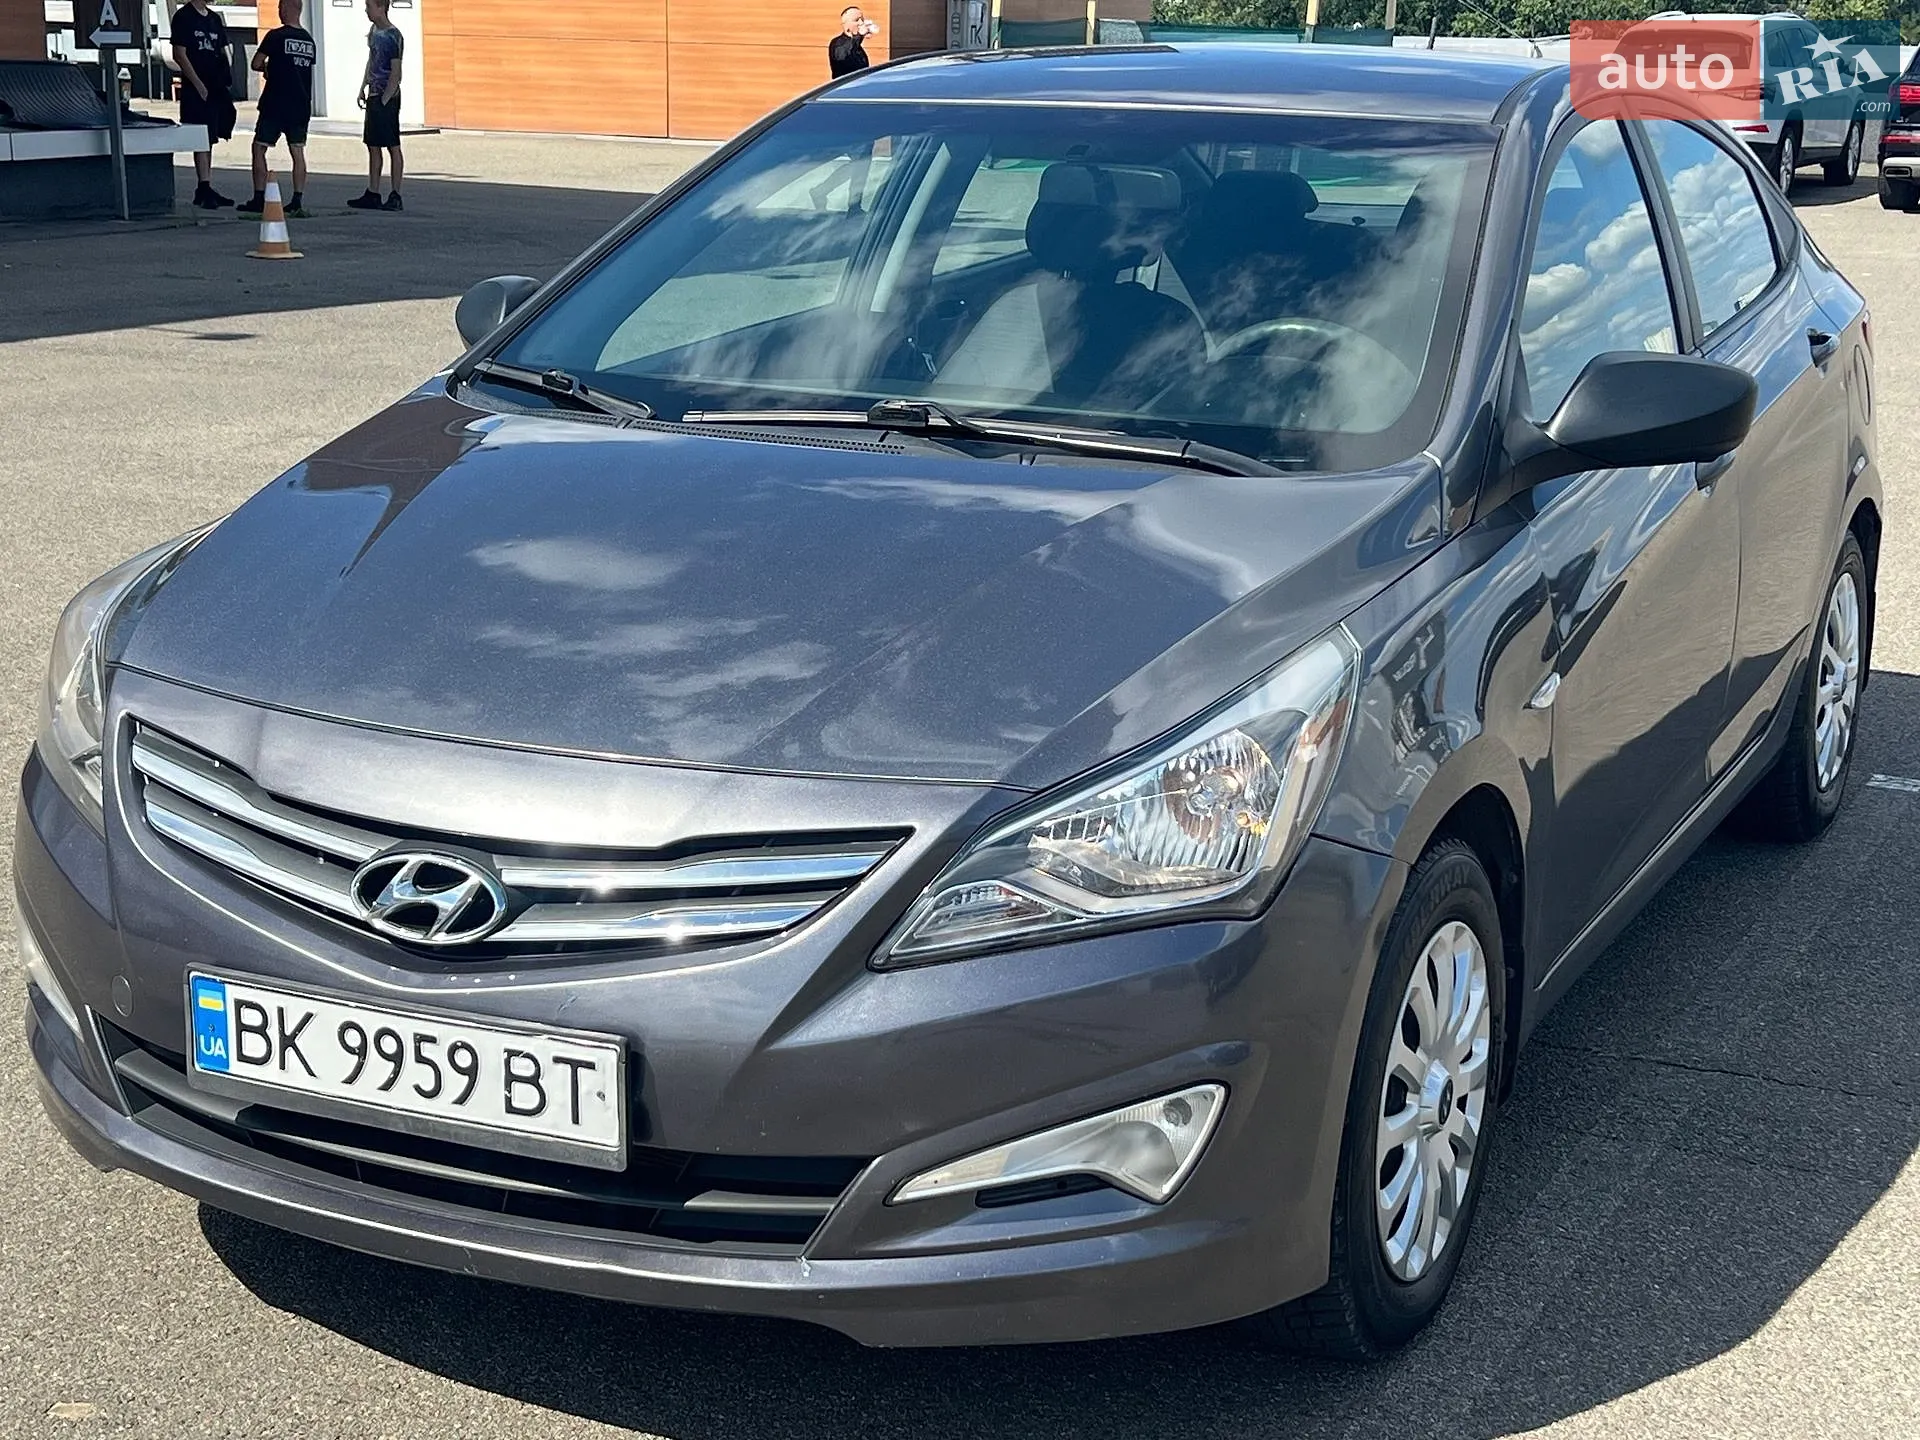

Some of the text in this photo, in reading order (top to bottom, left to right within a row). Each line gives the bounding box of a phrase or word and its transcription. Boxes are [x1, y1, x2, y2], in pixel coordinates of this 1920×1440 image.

[100, 0, 118, 25] A
[199, 1034, 227, 1060] UA
[234, 999, 597, 1126] BK 9959 BT
